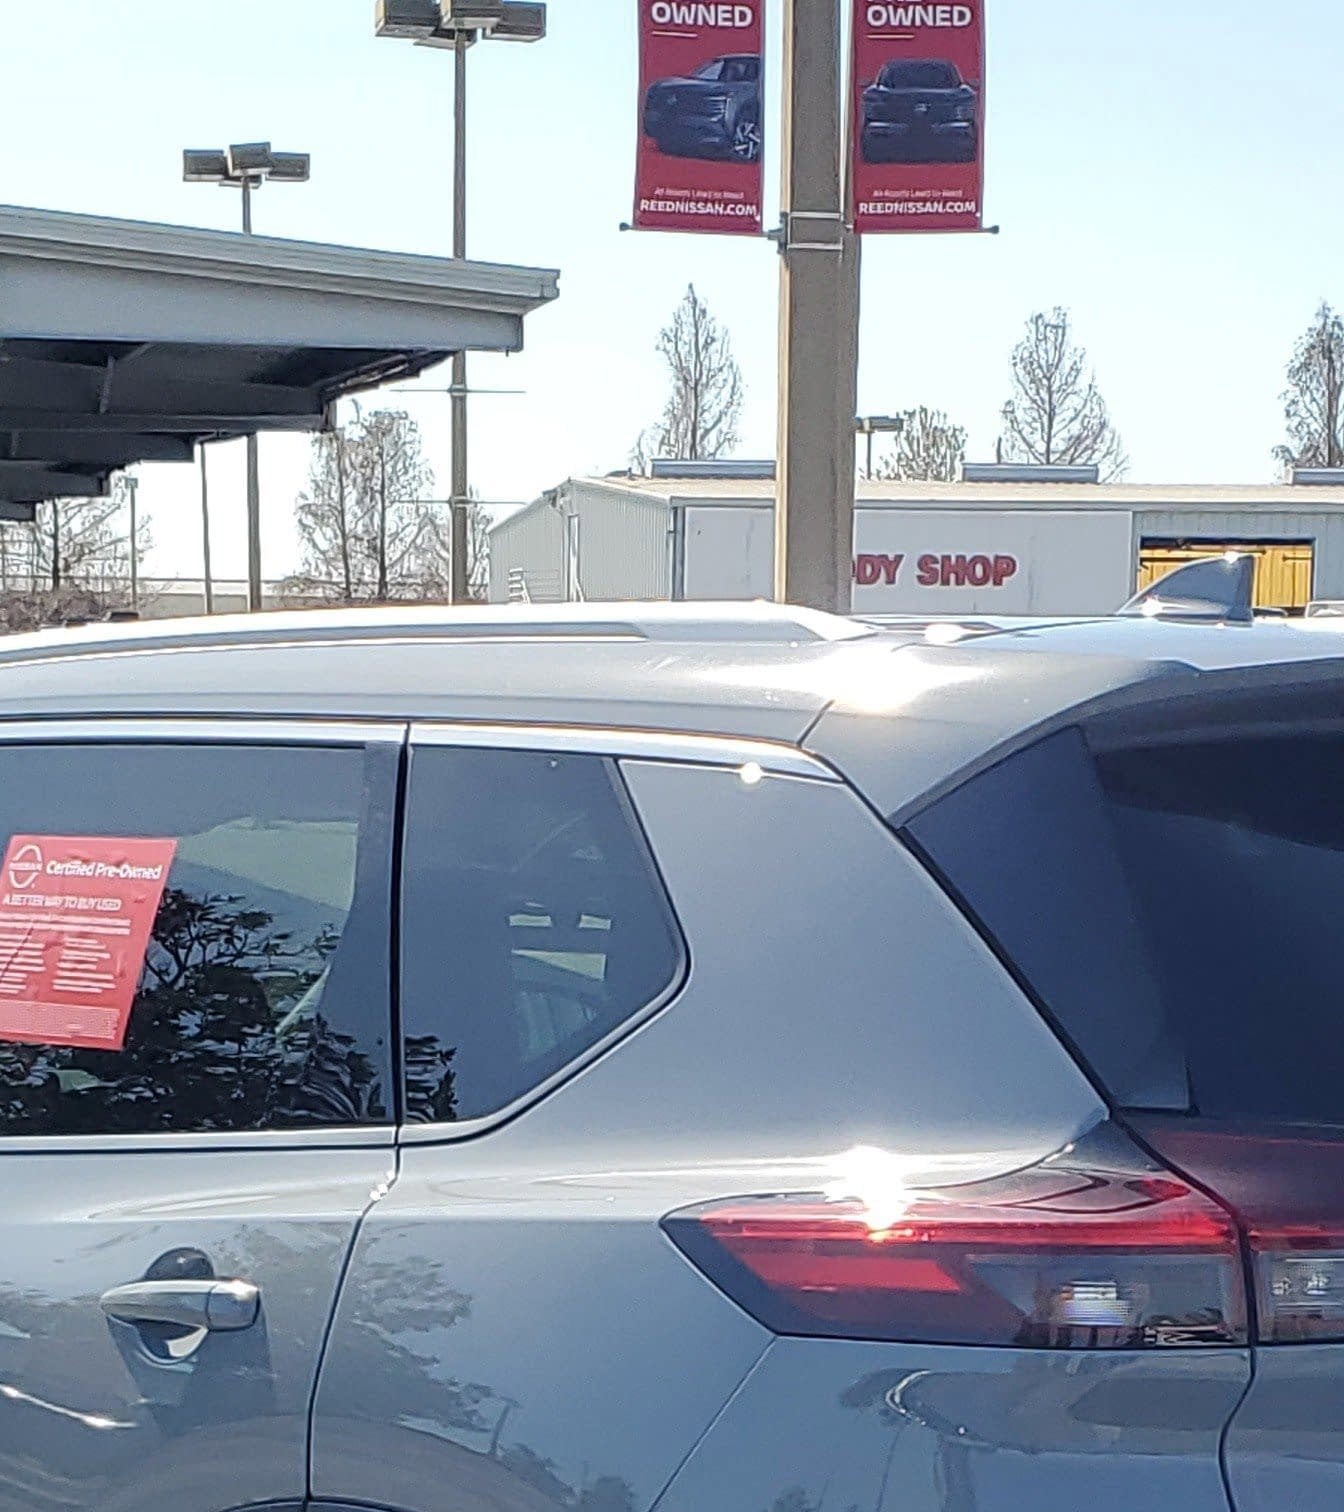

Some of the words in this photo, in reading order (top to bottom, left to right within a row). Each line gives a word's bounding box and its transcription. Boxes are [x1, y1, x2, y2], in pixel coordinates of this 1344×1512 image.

[651, 5, 753, 28] OWNED
[866, 6, 972, 28] OWNED
[639, 199, 757, 216] REEDNISSAN.COM
[858, 201, 977, 215] REEDNISSAN.COM
[852, 554, 905, 585] DY
[916, 554, 1017, 586] SHOP
[45, 859, 95, 876] Certified
[94, 863, 163, 880] Pre-Owned
